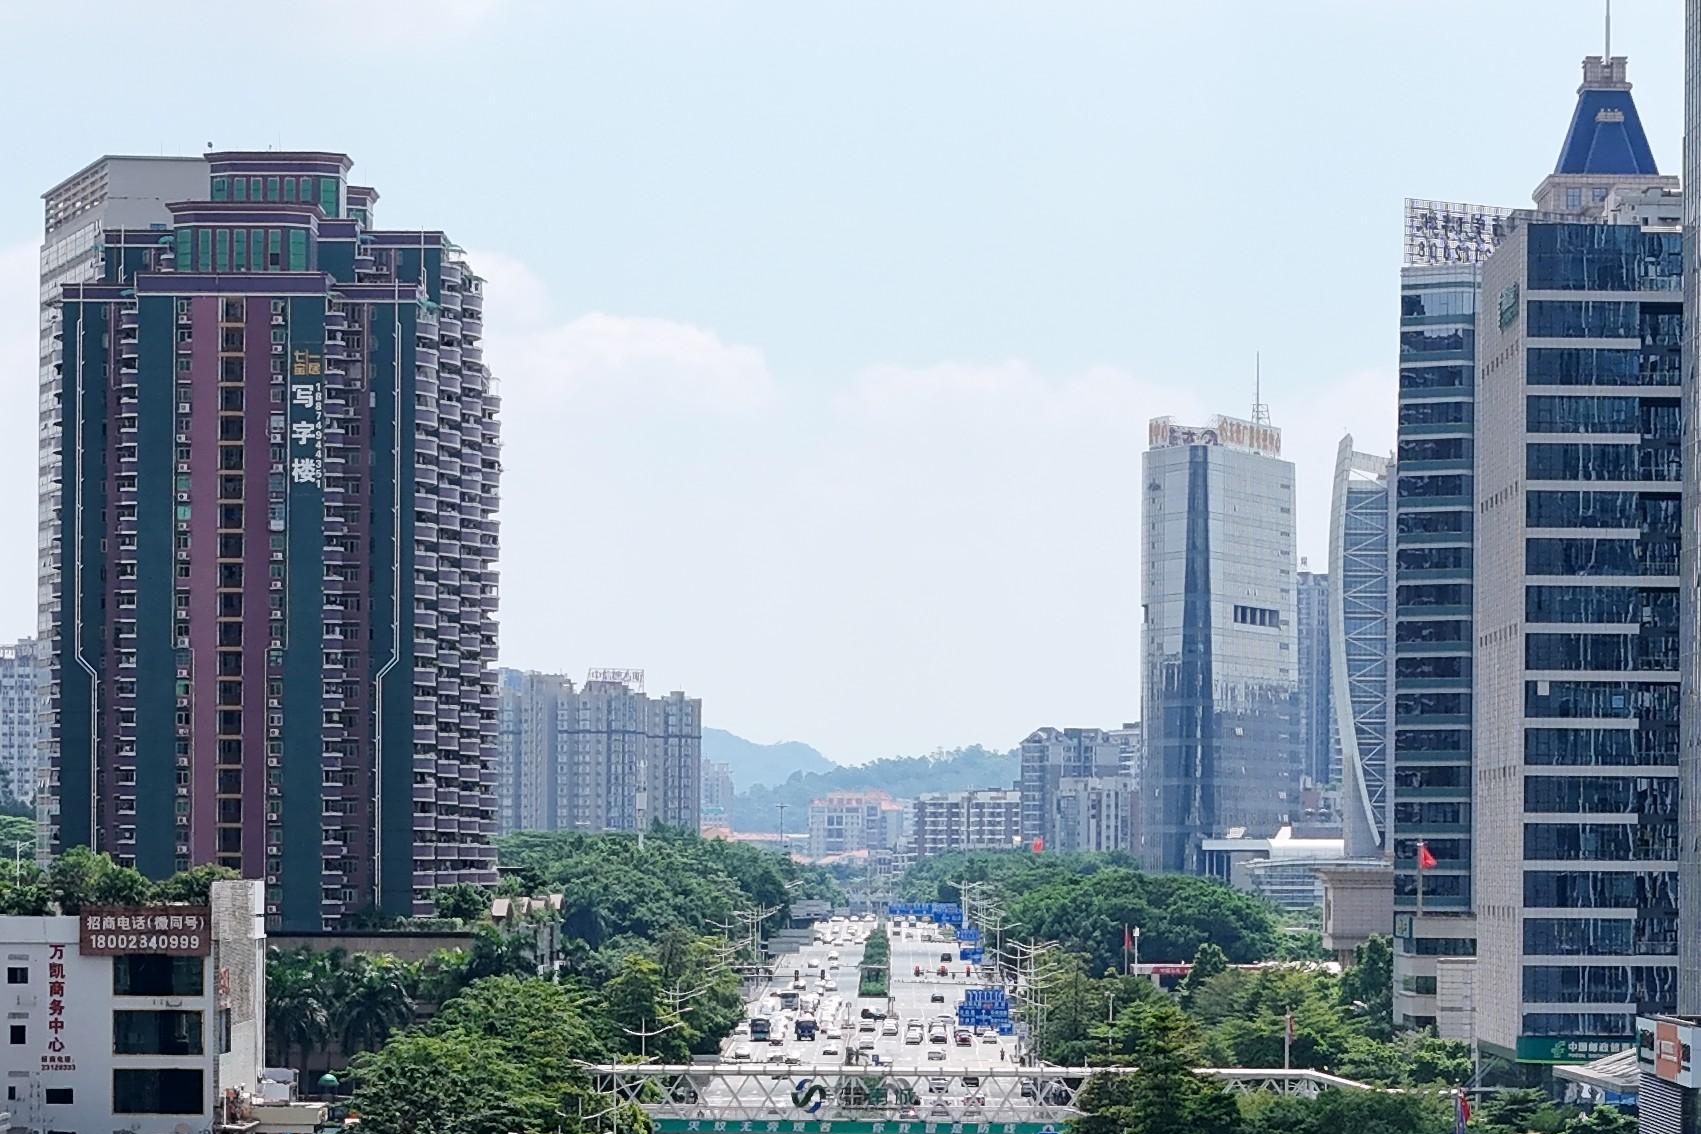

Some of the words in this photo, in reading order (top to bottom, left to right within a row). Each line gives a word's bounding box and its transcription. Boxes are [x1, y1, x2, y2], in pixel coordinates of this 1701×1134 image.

[292, 384, 315, 483] 写字楼
[87, 915, 204, 930] 招商电话(微同号)
[48, 945, 65, 1052] 万凯商务中心
[1568, 1041, 1638, 1052] 中国邮政储蓄
